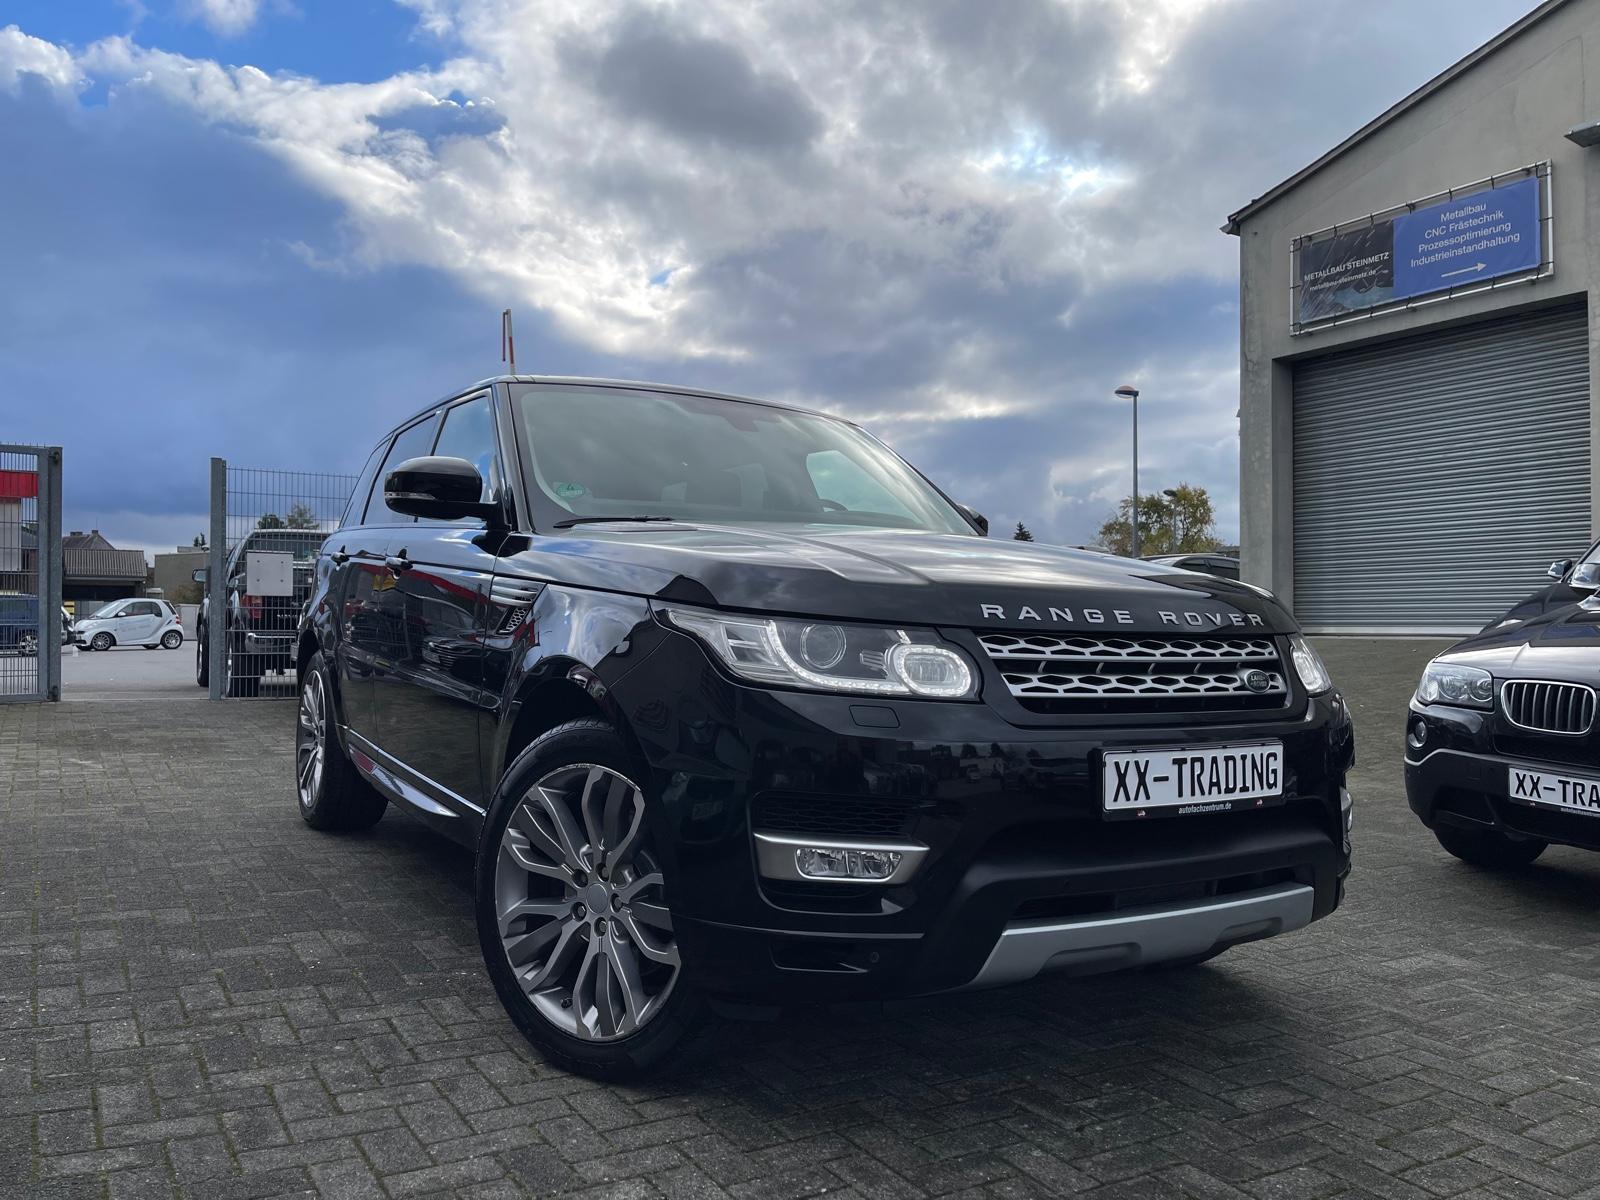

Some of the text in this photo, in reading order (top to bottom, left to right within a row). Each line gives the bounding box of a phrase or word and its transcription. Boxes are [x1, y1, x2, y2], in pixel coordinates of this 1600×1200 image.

[1425, 210, 1504, 239] CNC Frästechnik
[1440, 203, 1487, 222] Metallbau
[1410, 233, 1520, 268] Industrieinstandhaltung
[1418, 223, 1511, 253] Prozessoptimierung
[1304, 252, 1390, 281] METALLBAU STEINMETZ
[980, 603, 1265, 626] RANGE ROVER
[1113, 752, 1278, 802] XX-TRADING
